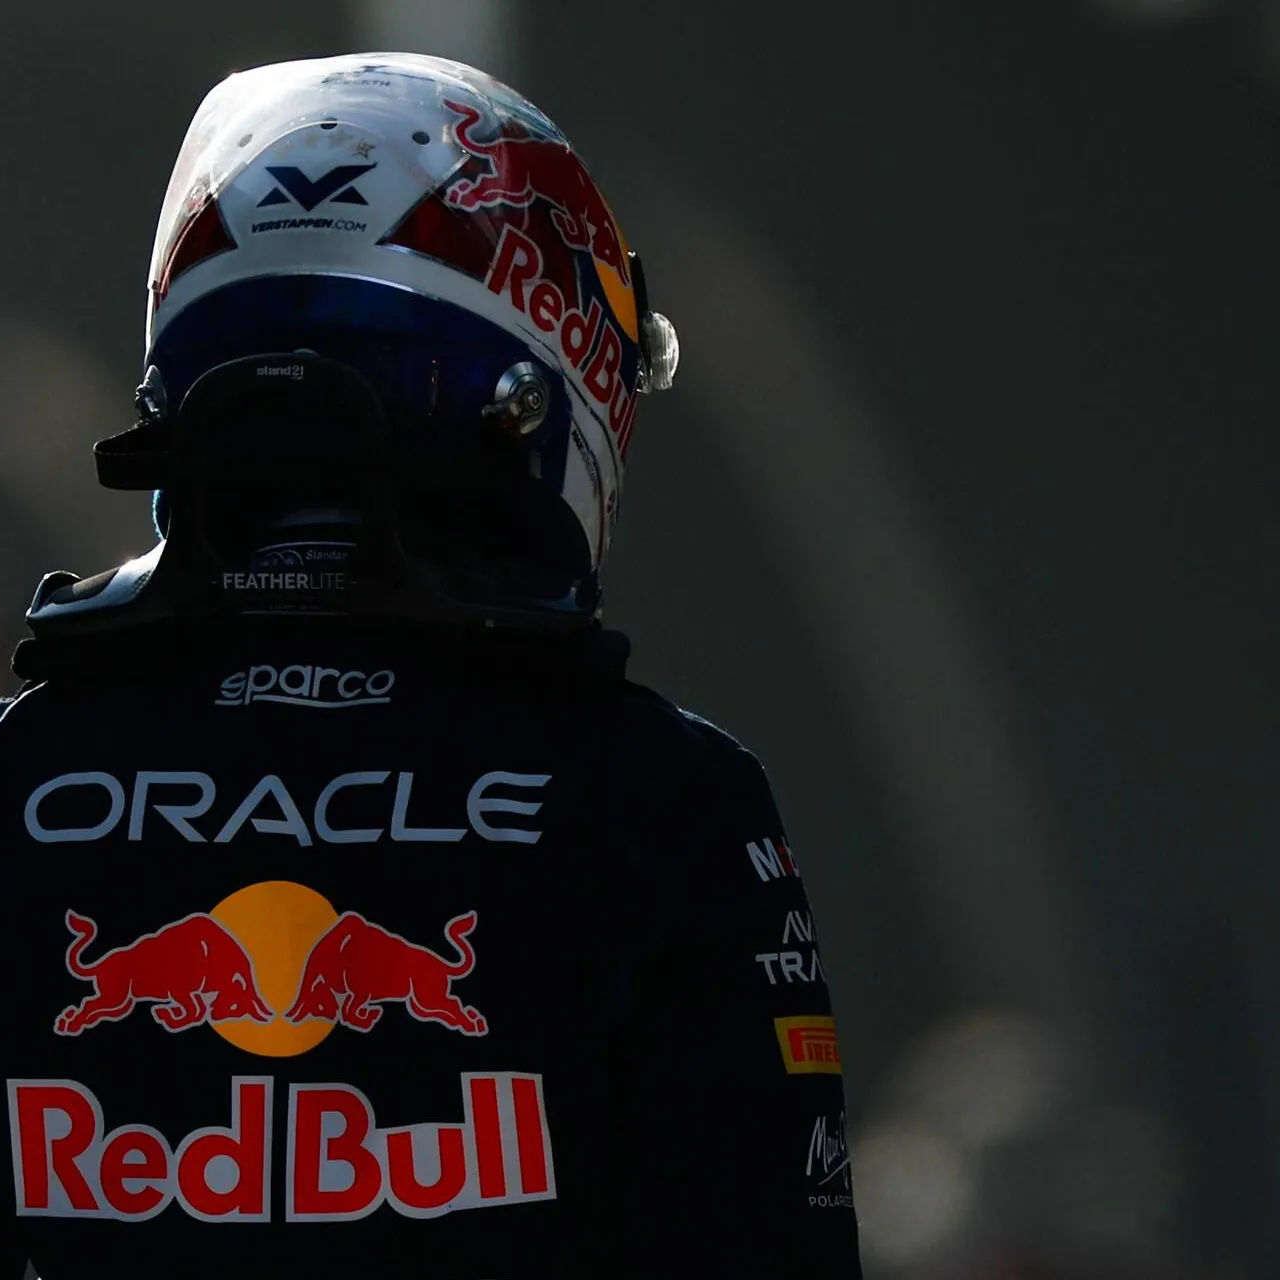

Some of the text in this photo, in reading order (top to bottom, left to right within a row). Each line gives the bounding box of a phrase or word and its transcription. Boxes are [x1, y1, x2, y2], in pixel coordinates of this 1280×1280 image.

[251, 218, 367, 233] VERSTAPPEN.COM
[484, 222, 603, 370] Red
[222, 572, 345, 590] FEATHERLITE
[219, 664, 396, 707] sparco
[23, 770, 553, 848] ORACLE
[6, 1071, 557, 1223] Red Bull
